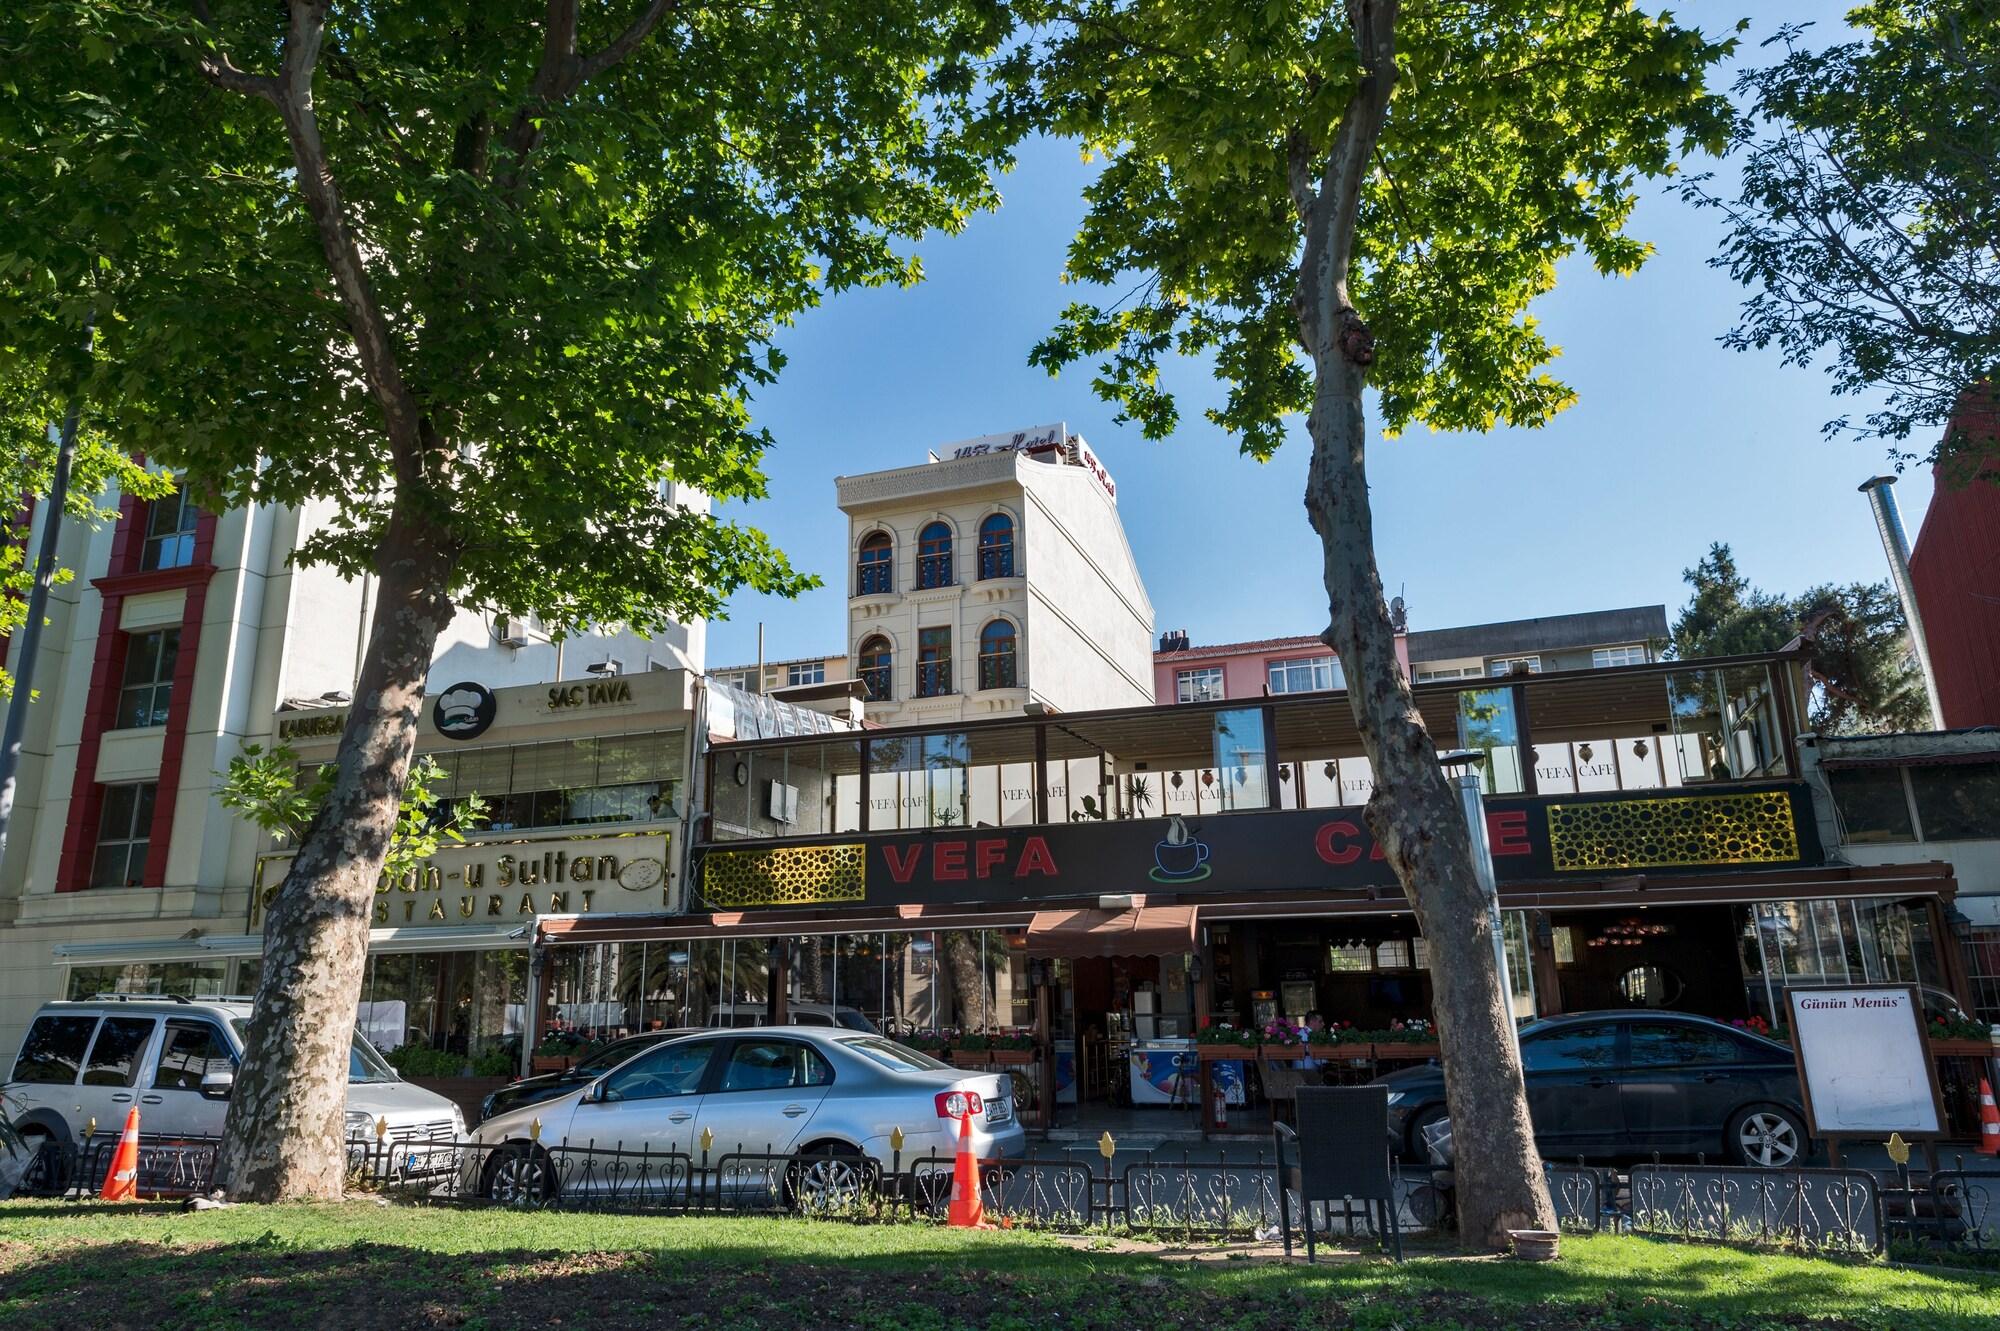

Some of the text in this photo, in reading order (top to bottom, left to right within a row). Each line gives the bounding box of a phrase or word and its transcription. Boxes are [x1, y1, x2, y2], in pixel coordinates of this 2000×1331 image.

[586, 680, 632, 705] TAVA
[1536, 763, 1616, 780] VEFA CAFE
[1002, 788, 1032, 801] VEFA
[497, 849, 619, 888] Sultan
[881, 836, 1061, 884] VEFA
[1800, 998, 1847, 1010] Günün
